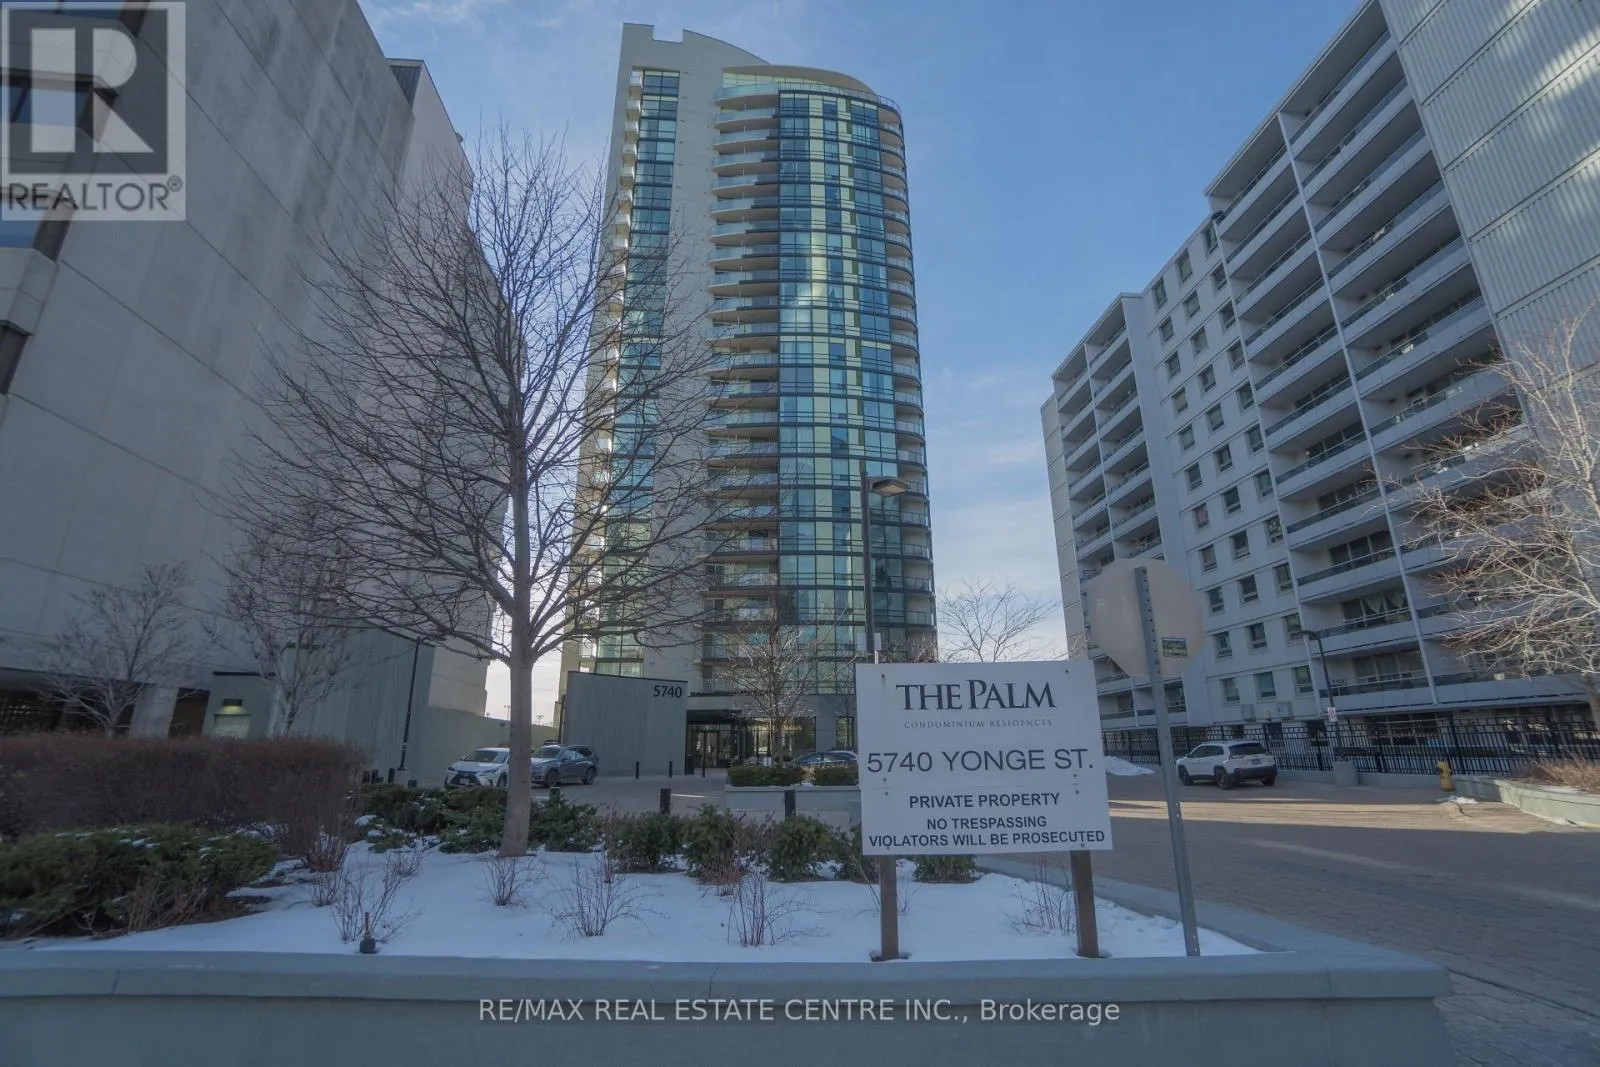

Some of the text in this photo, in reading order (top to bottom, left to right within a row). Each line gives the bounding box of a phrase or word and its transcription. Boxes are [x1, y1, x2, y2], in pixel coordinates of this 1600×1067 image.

[653, 684, 682, 698] 5740
[896, 679, 1057, 710] THE PALM
[904, 718, 1053, 729] CONDOMINIUM RESIDENCES
[867, 748, 1094, 772] 5740 YONGE ST.
[909, 792, 1060, 808] PRIVATE PROPERTY
[927, 816, 1047, 830] NO TRESPASSING
[869, 830, 1105, 847] VIOLATORS WILL BE PROSECUTED
